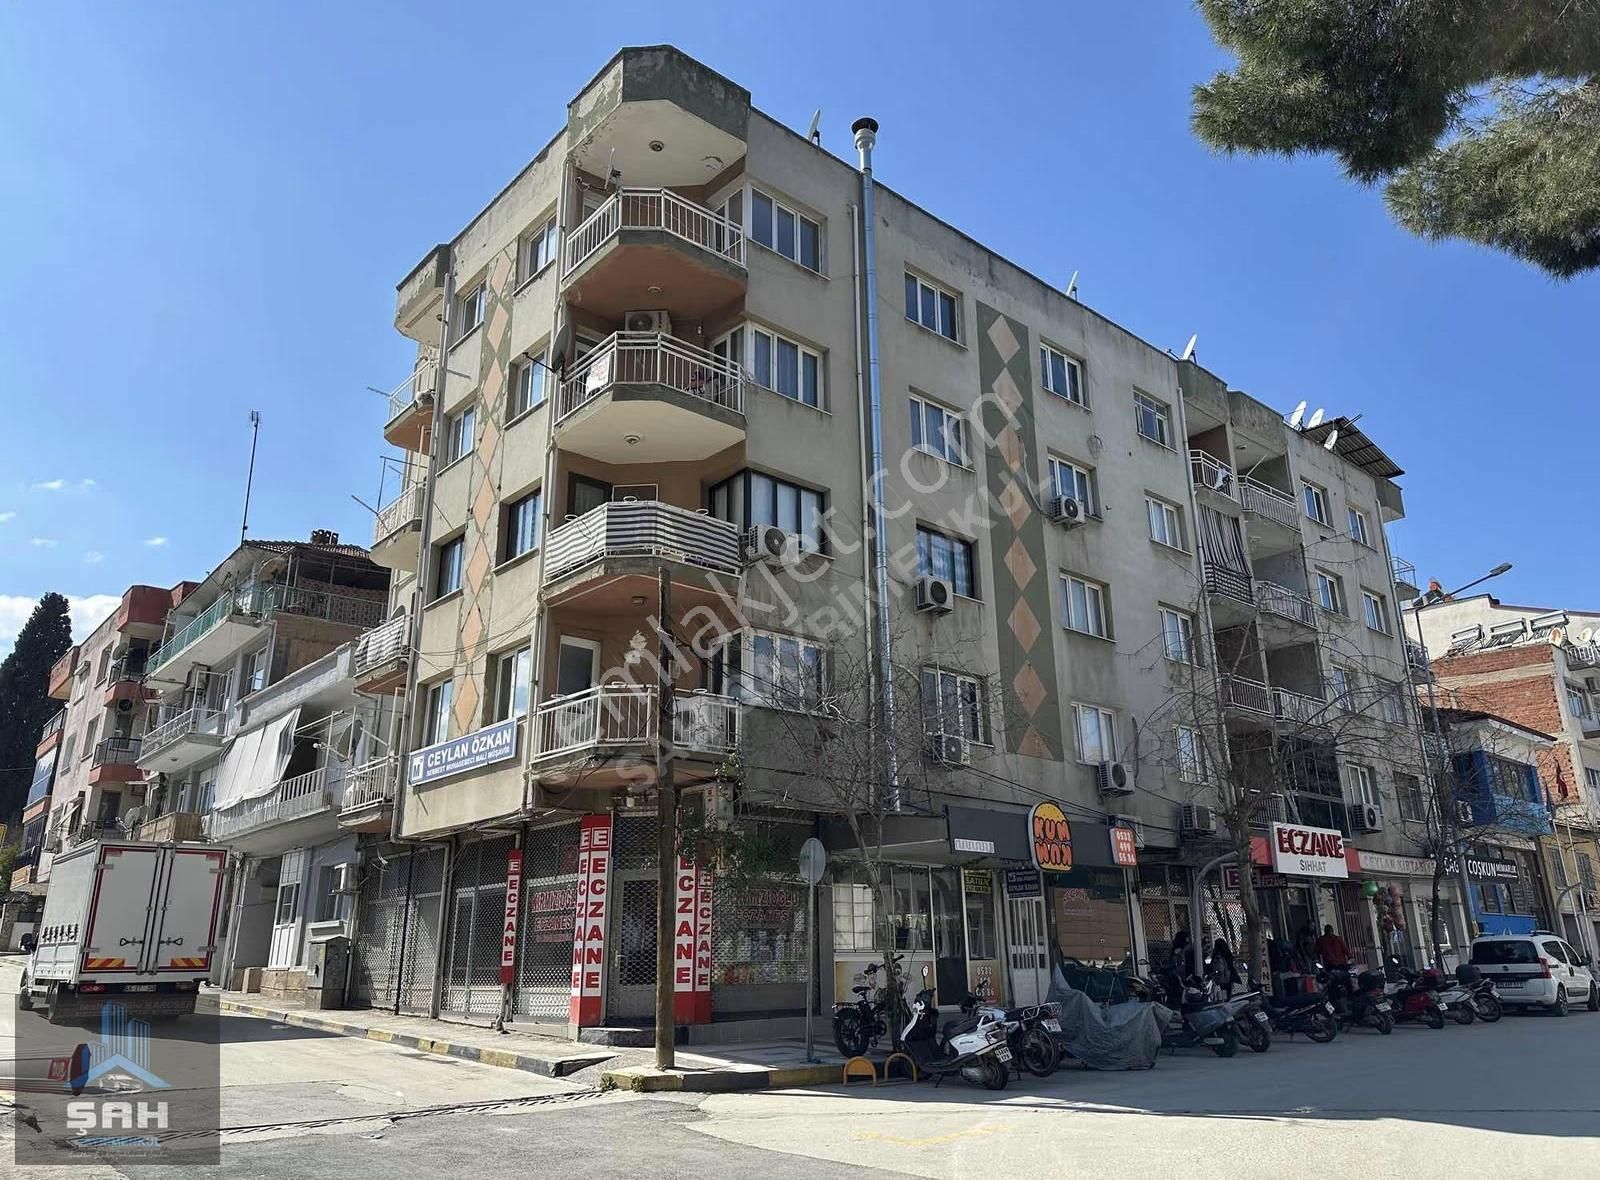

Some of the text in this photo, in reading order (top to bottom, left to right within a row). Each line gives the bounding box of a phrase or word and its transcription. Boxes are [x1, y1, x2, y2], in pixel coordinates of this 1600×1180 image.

[427, 728, 512, 767] CEYLAN ÖZKAN
[1277, 827, 1345, 859] ECZANE
[1467, 859, 1497, 879] COŞKUN
[503, 880, 518, 961] ECZANE
[573, 859, 587, 988] ECZANE
[585, 858, 607, 988] ECZANE
[698, 890, 711, 985] ECZANE
